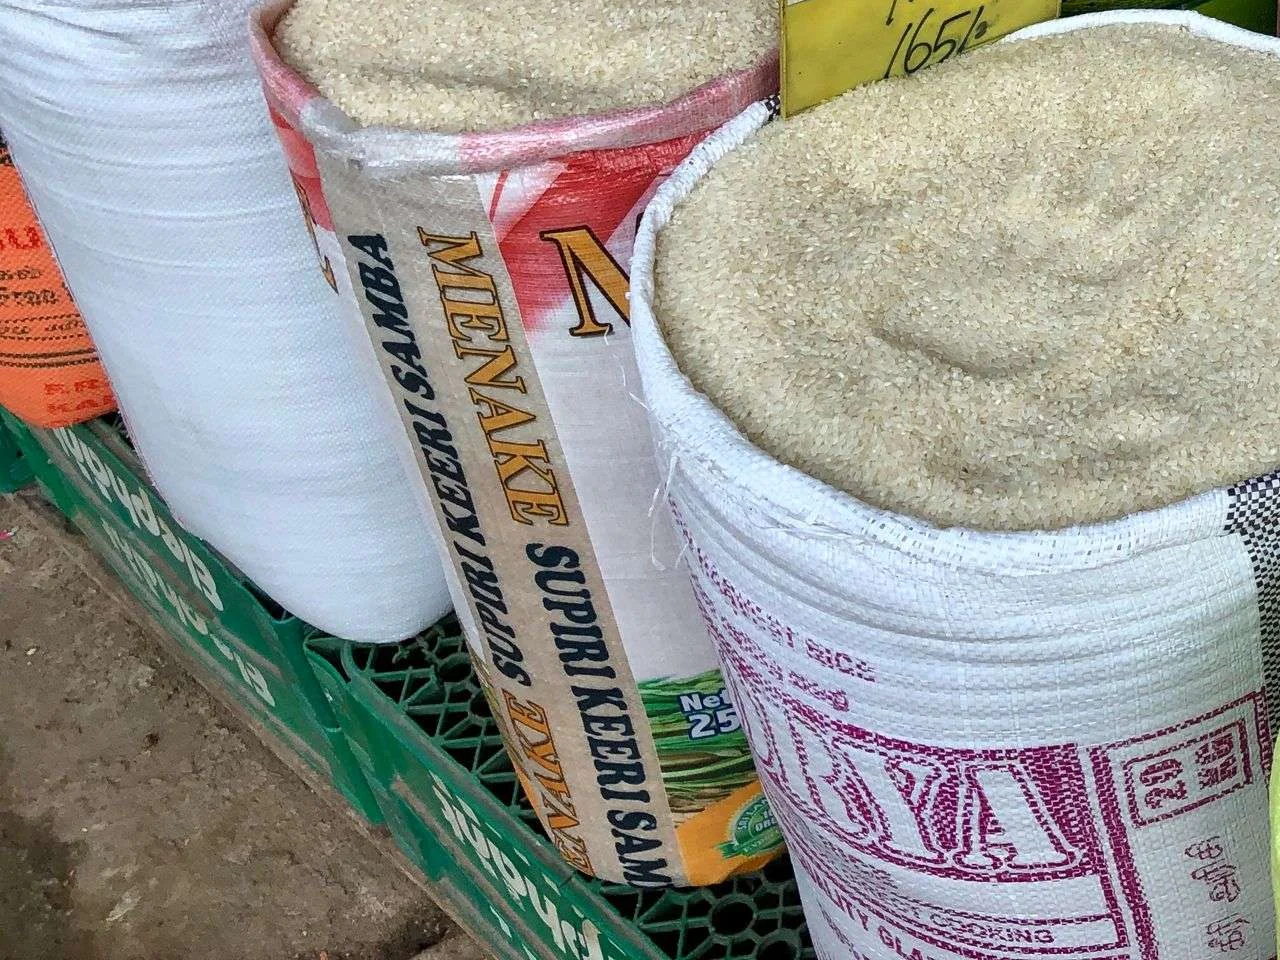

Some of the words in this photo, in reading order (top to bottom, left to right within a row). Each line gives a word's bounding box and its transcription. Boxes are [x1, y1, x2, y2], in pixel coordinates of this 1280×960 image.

[347, 232, 436, 402] SAMBA
[416, 225, 570, 528] MENAKE
[403, 398, 487, 550] KEERI
[449, 539, 532, 688] SUPIRI
[524, 542, 617, 680] SUPIRI
[570, 684, 652, 805] KEERI
[688, 711, 741, 739] 25
